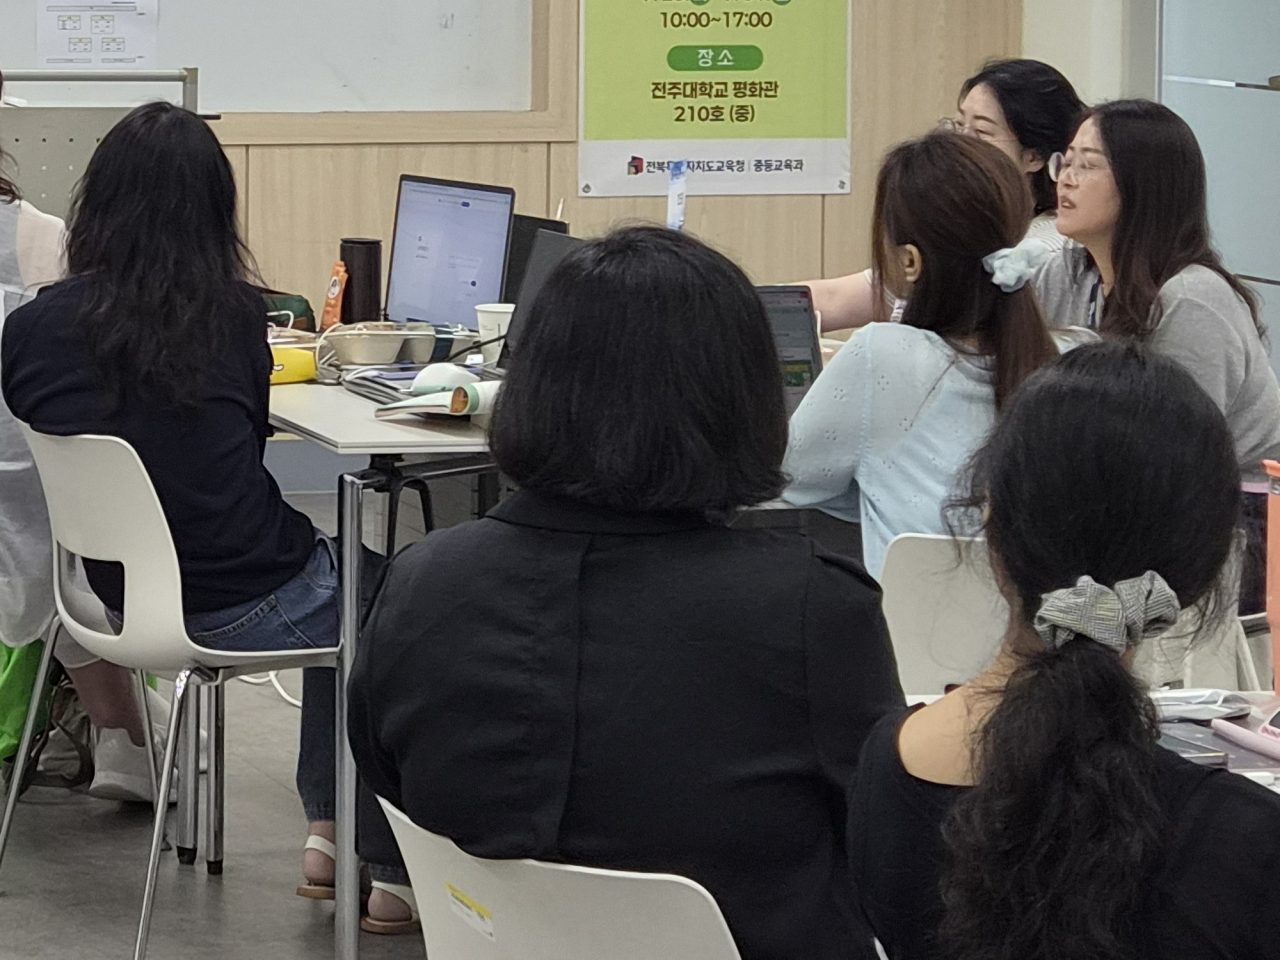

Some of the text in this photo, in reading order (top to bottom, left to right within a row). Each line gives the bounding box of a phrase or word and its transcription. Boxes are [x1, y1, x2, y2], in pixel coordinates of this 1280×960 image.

[660, 11, 773, 28] 10:00~17:00
[651, 81, 779, 99] 전주대학교 평화관
[673, 104, 755, 123] 210호 (중)
[646, 159, 804, 174] 전북자치도교육청 중등교육과
